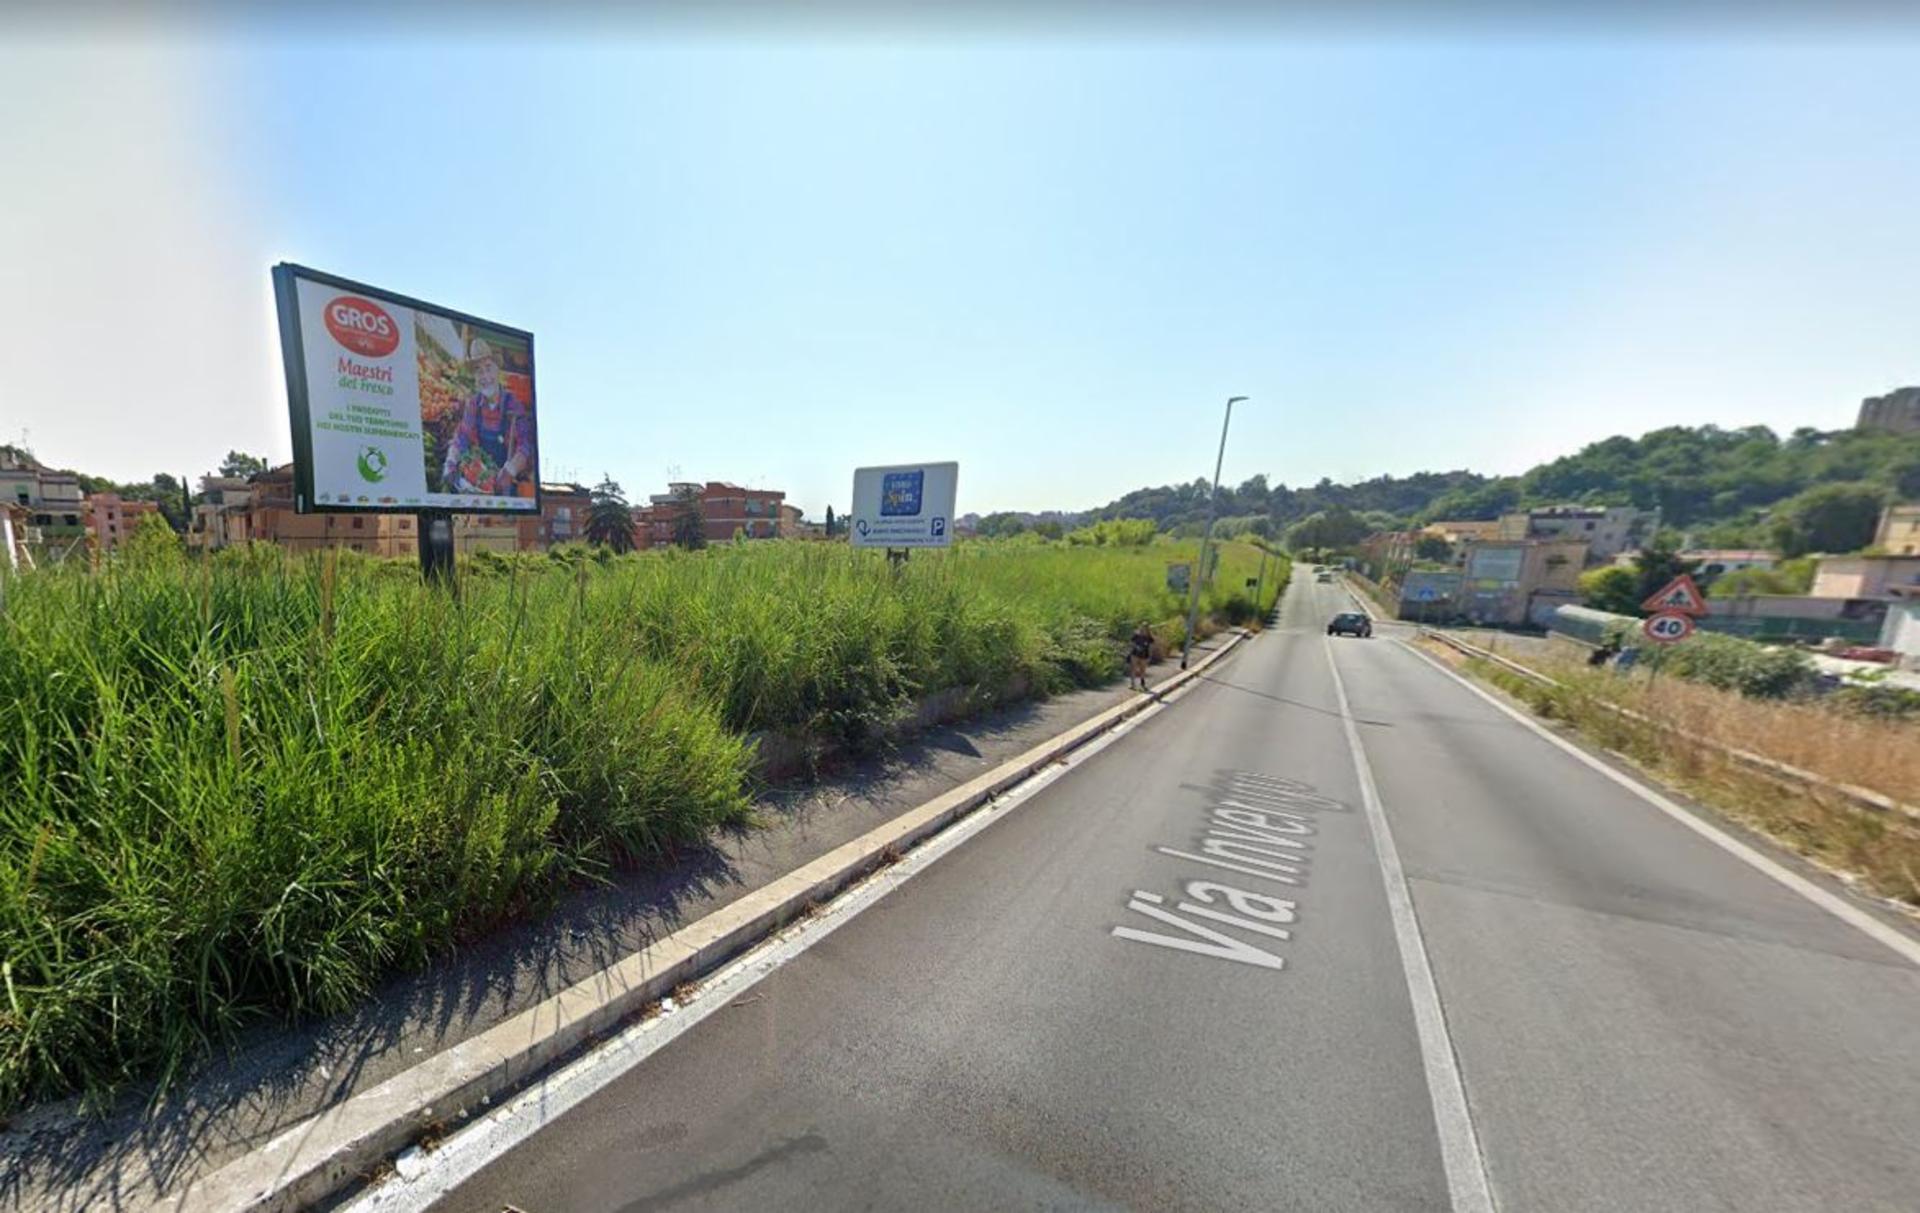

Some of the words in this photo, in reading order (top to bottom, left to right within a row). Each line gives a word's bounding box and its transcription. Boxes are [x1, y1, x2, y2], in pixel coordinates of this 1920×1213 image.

[332, 305, 390, 335] GROS
[338, 357, 393, 382] Maestri
[934, 520, 944, 534] P
[1654, 620, 1681, 635] 40
